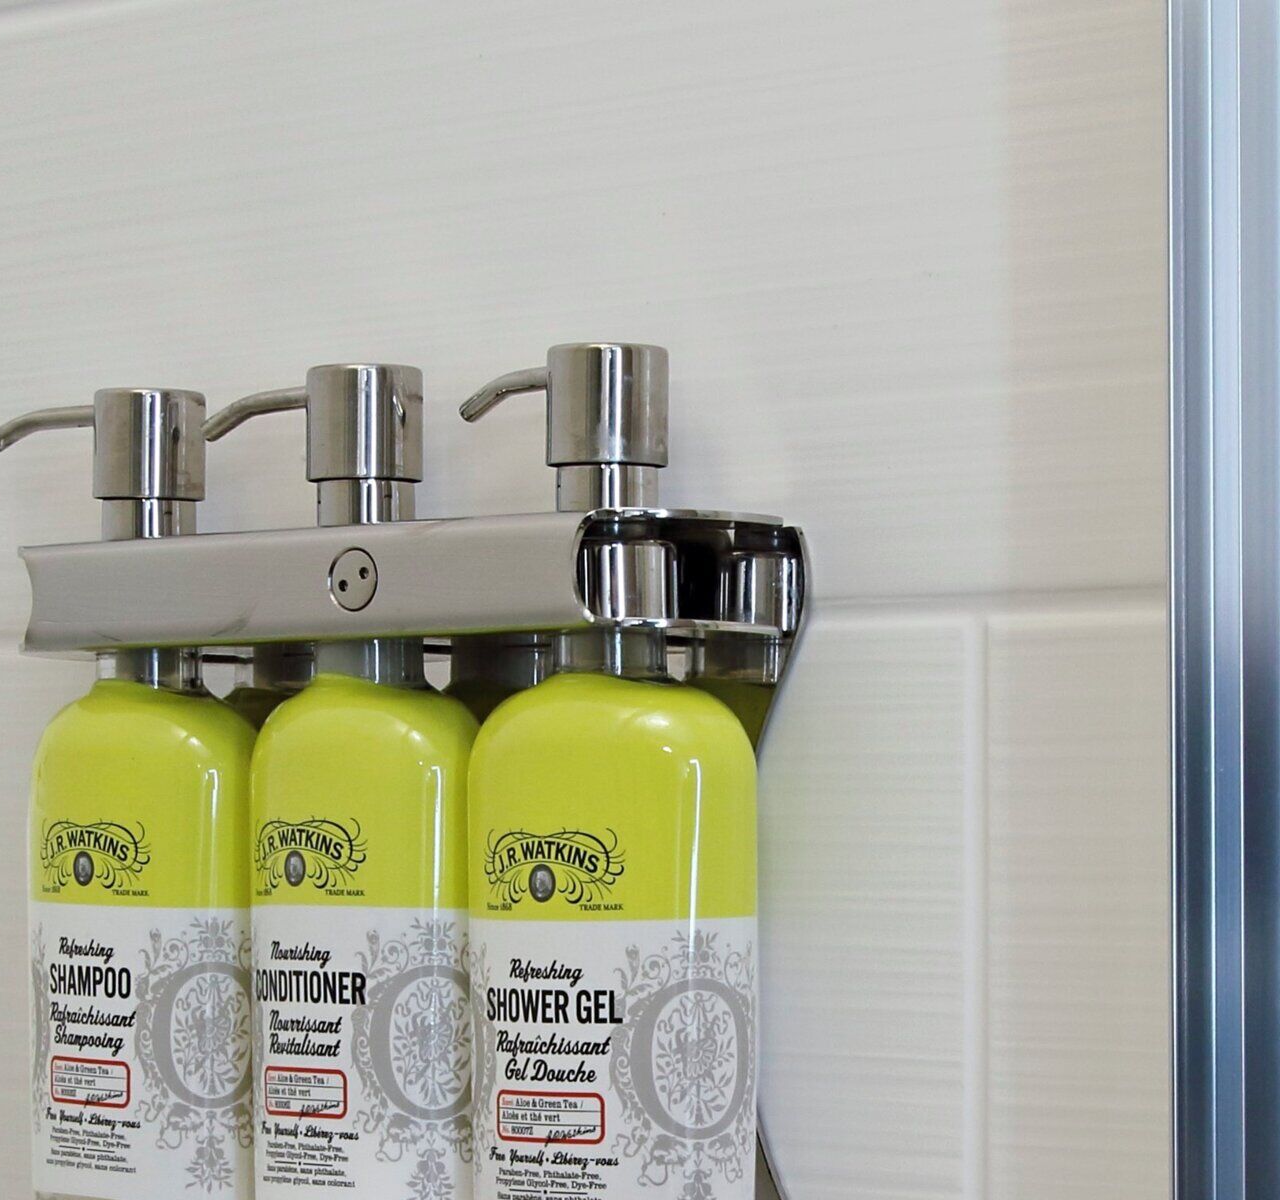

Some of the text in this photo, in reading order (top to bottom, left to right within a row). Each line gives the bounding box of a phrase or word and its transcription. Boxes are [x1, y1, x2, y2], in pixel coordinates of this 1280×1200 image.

[50, 829, 130, 862] J.R. WATKINS
[262, 828, 344, 860] J.R. WATKINS
[498, 840, 599, 873] J.R. WATKINS
[59, 936, 114, 964] Refreshing
[270, 940, 331, 969] Nourishing
[50, 963, 131, 999] SHAMPOO
[256, 969, 366, 1005] CONDITIONER
[509, 958, 583, 987] Refreshing
[50, 1002, 137, 1028] Rafraîchissant
[487, 987, 623, 1024] SHOWER GEL
[269, 1010, 342, 1034] Nourrissant
[54, 1024, 125, 1057] Shampooing
[269, 1033, 341, 1057] Revitalisant
[496, 1030, 611, 1057] Rafraîchissant
[505, 1057, 597, 1083] Gel Douche
[538, 1098, 562, 1108] Green
[563, 1099, 578, 1109] Tea
